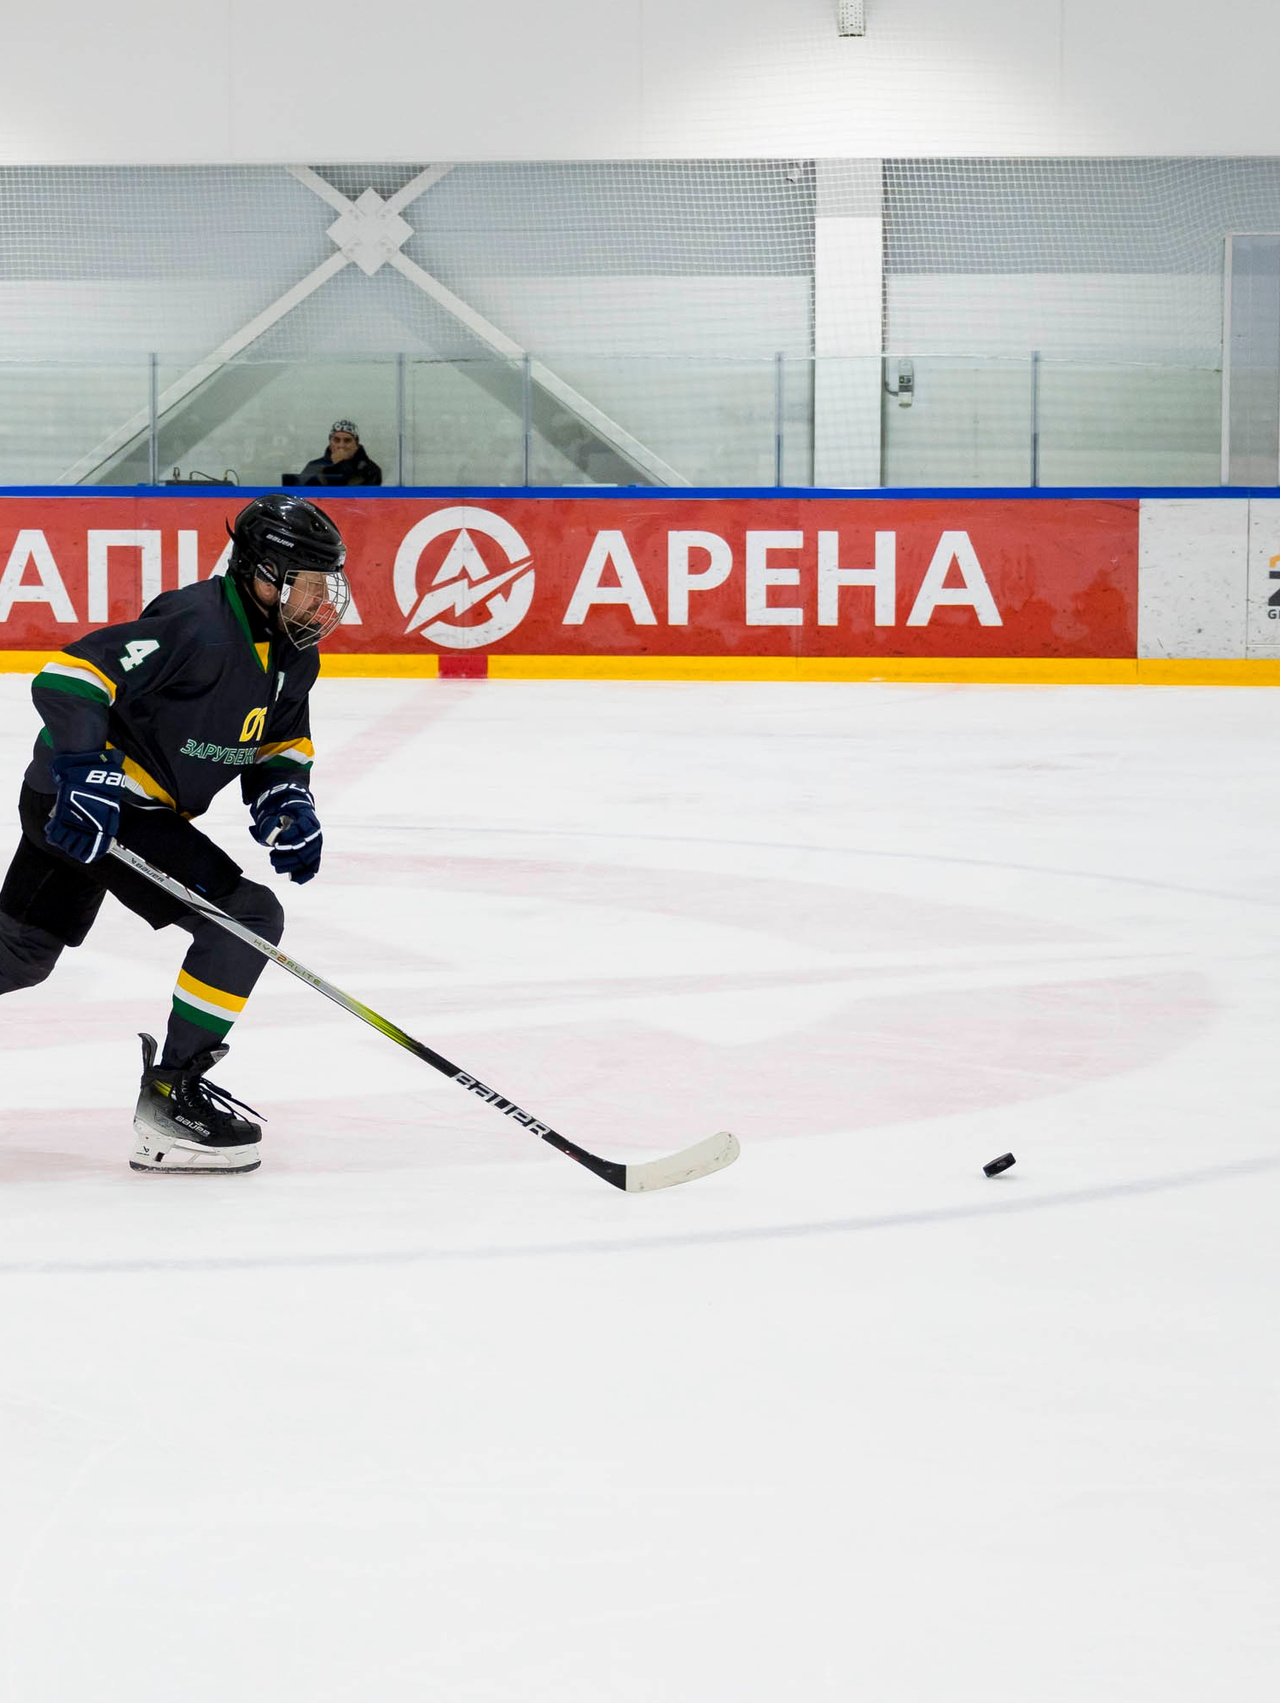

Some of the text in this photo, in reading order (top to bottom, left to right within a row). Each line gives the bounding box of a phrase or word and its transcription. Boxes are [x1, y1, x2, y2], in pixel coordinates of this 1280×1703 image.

[265, 533, 295, 549] BAUER
[562, 529, 1004, 627] АРЕНА
[119, 639, 160, 672] 4
[453, 1071, 552, 1139] BAUER
[174, 1115, 211, 1138] BAUER
